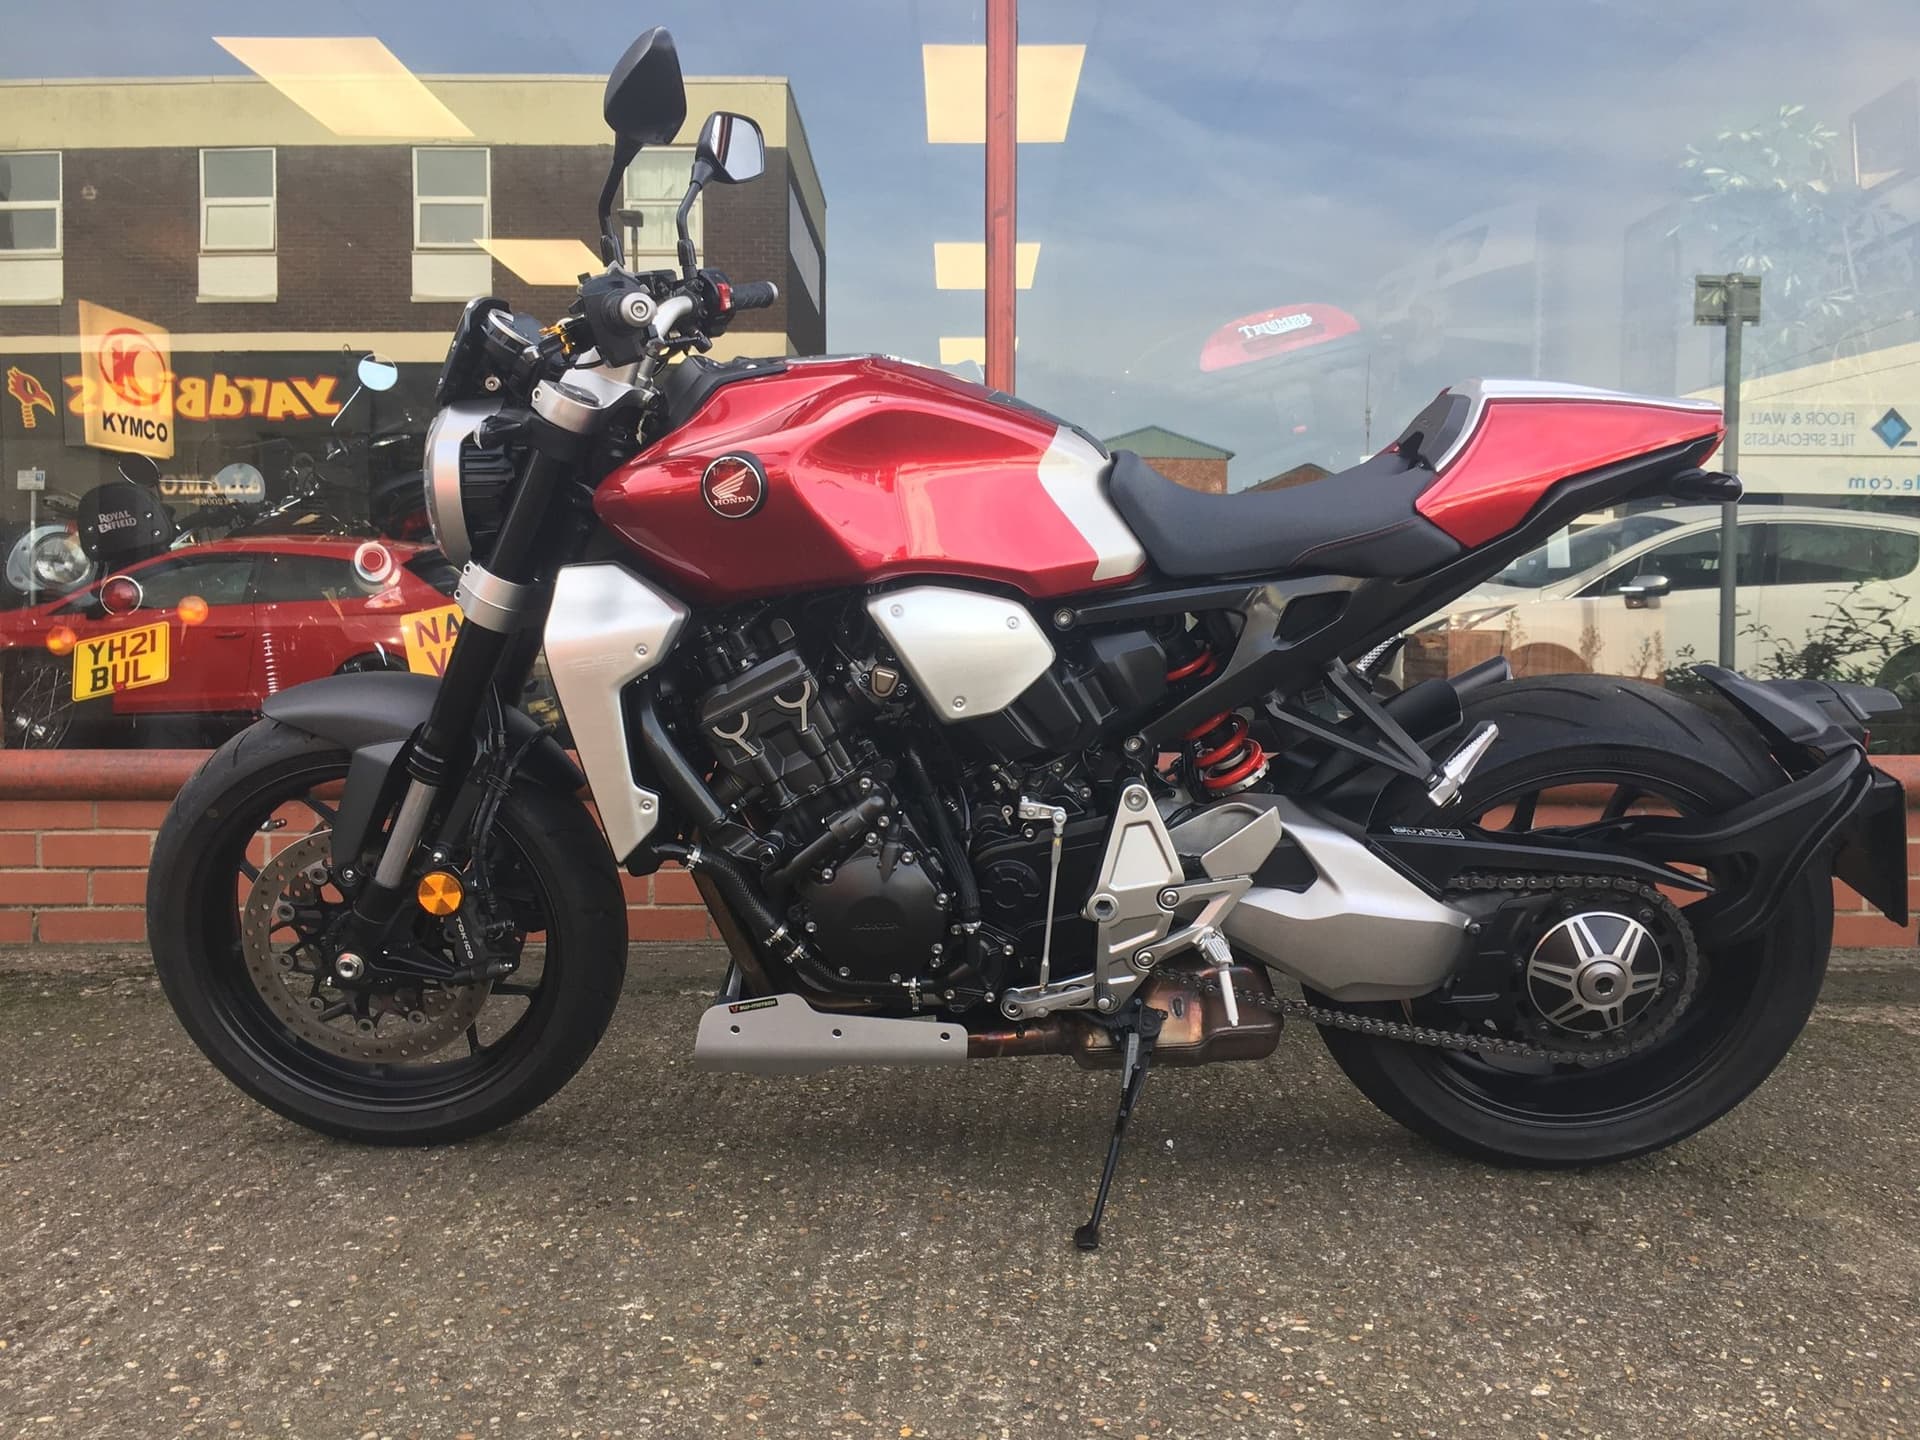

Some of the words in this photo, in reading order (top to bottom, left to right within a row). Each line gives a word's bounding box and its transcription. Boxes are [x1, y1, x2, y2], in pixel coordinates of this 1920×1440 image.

[102, 411, 168, 442] KYMCO
[714, 495, 755, 506] HONDA
[97, 517, 137, 533] ENFIELD
[98, 510, 131, 524] ROYAL
[88, 629, 156, 666] YH21
[90, 659, 151, 692] BUL
[455, 915, 474, 960] TOKICO
